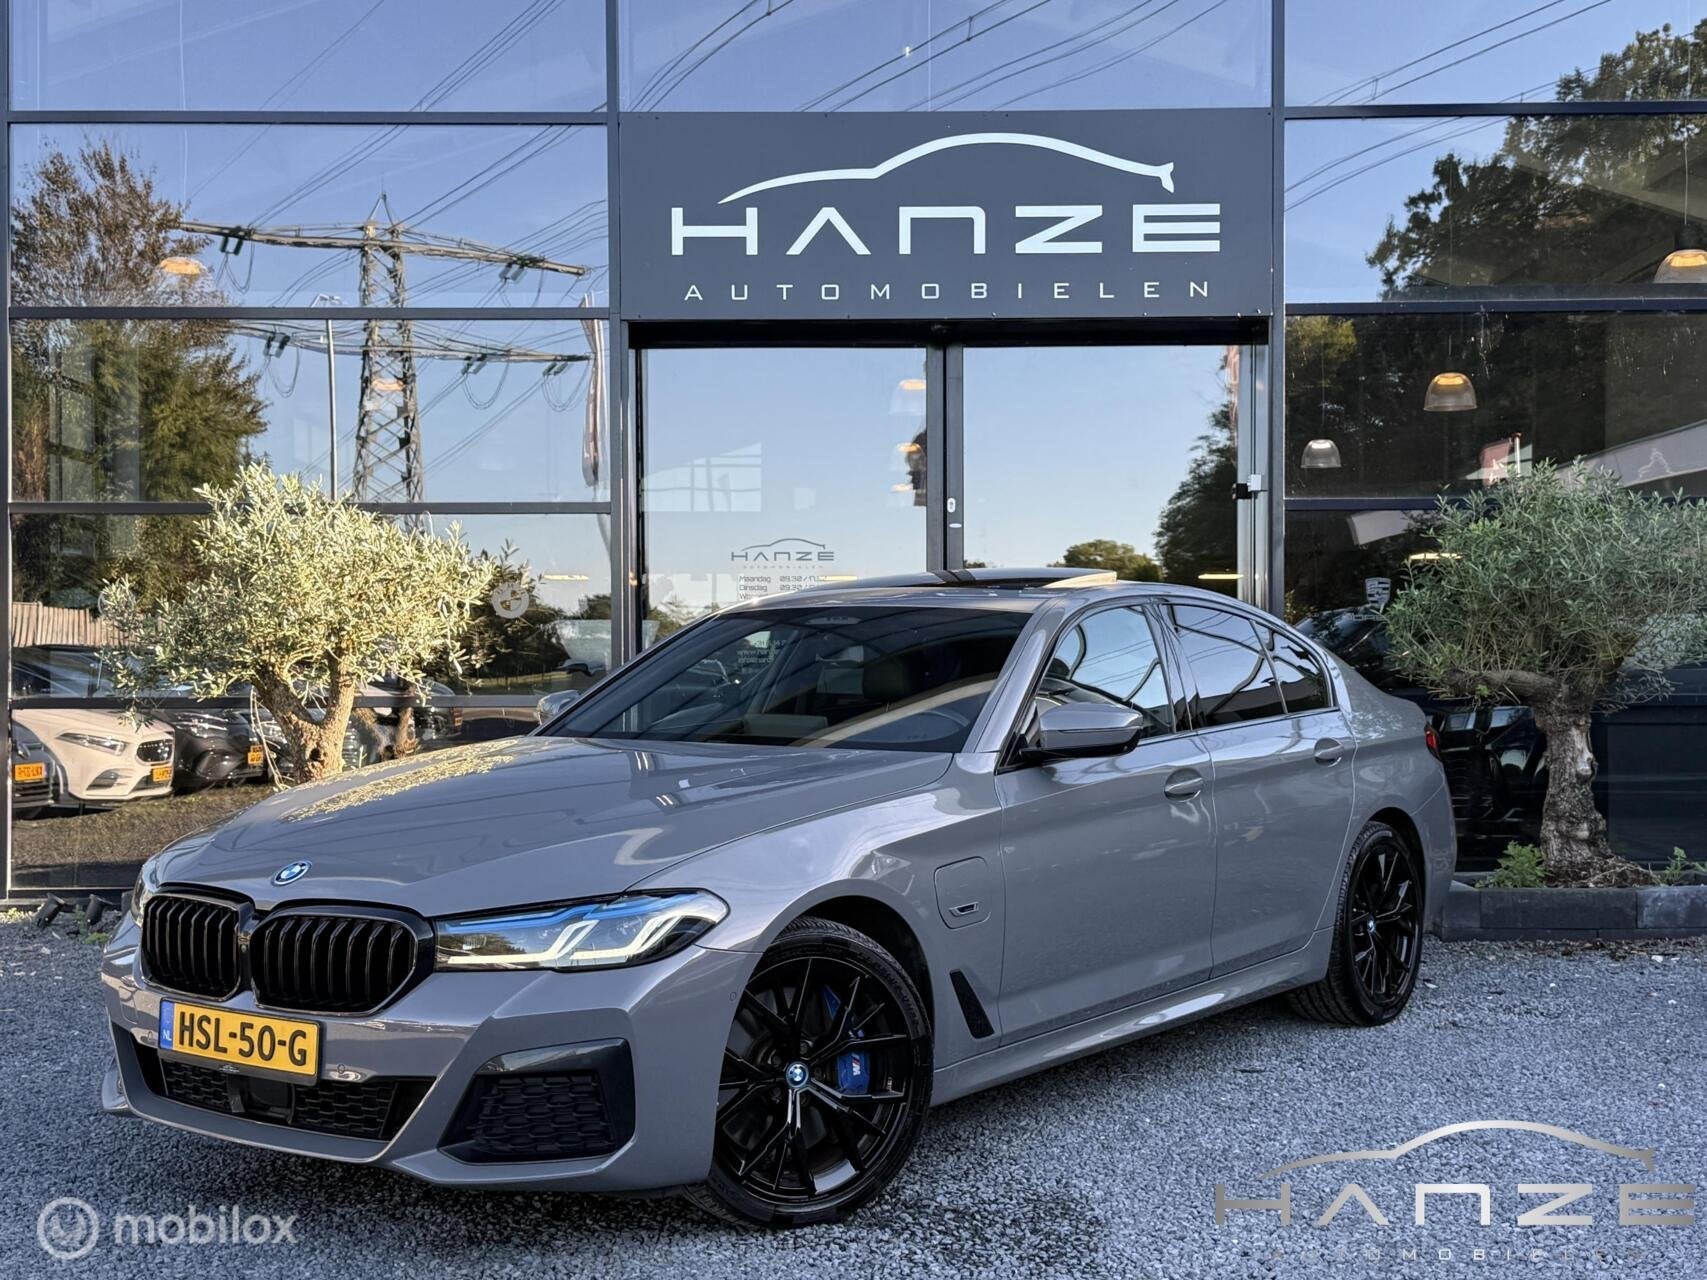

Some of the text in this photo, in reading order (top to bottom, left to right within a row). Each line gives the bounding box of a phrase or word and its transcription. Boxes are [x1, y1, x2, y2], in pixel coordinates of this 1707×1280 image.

[671, 203, 1221, 256] HANZE
[684, 281, 1209, 301] AUTOMOBIELEN
[731, 551, 835, 561] HANZE
[739, 575, 772, 583] Maandag
[739, 584, 768, 592] Dinsdag
[162, 1030, 172, 1042] NL
[178, 1011, 308, 1067] HSL-50-G
